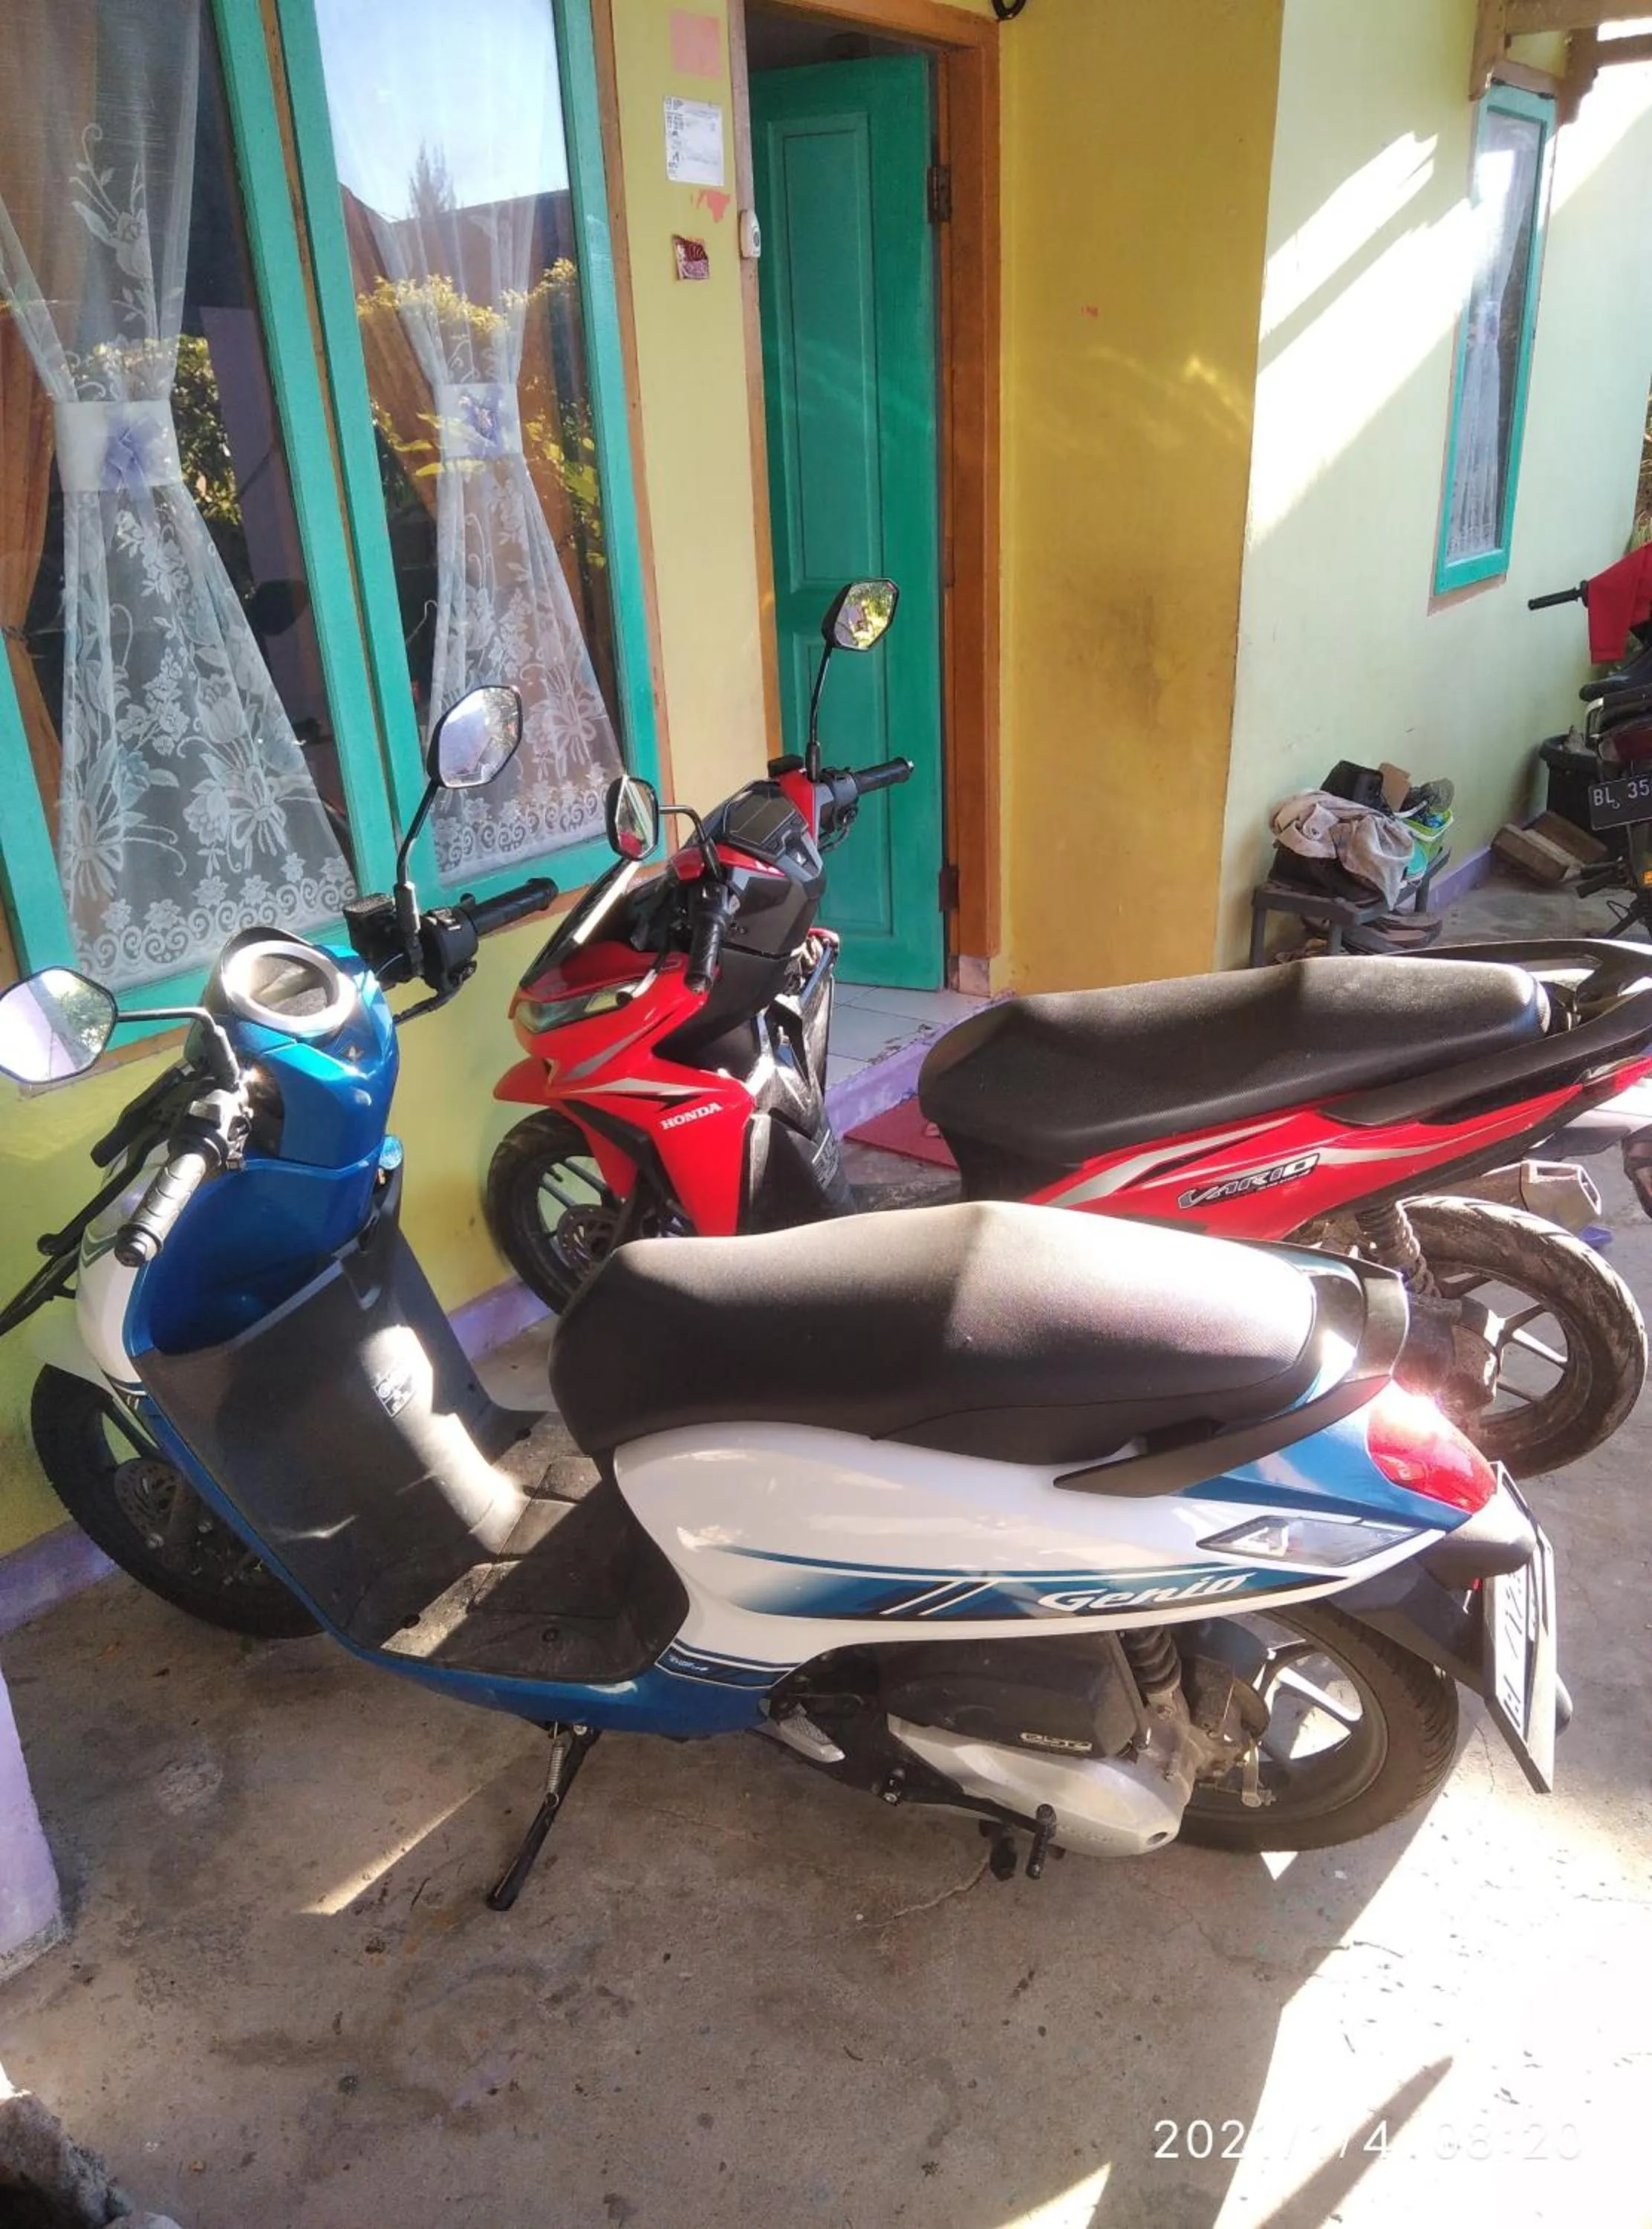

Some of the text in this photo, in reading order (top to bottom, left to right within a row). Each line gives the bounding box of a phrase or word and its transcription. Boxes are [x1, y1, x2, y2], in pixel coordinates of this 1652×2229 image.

[1593, 787, 1615, 806] BL
[660, 1102, 723, 1129] HONDA
[1178, 1153, 1319, 1208] VARIO
[1038, 1572, 1259, 1612] Genio
